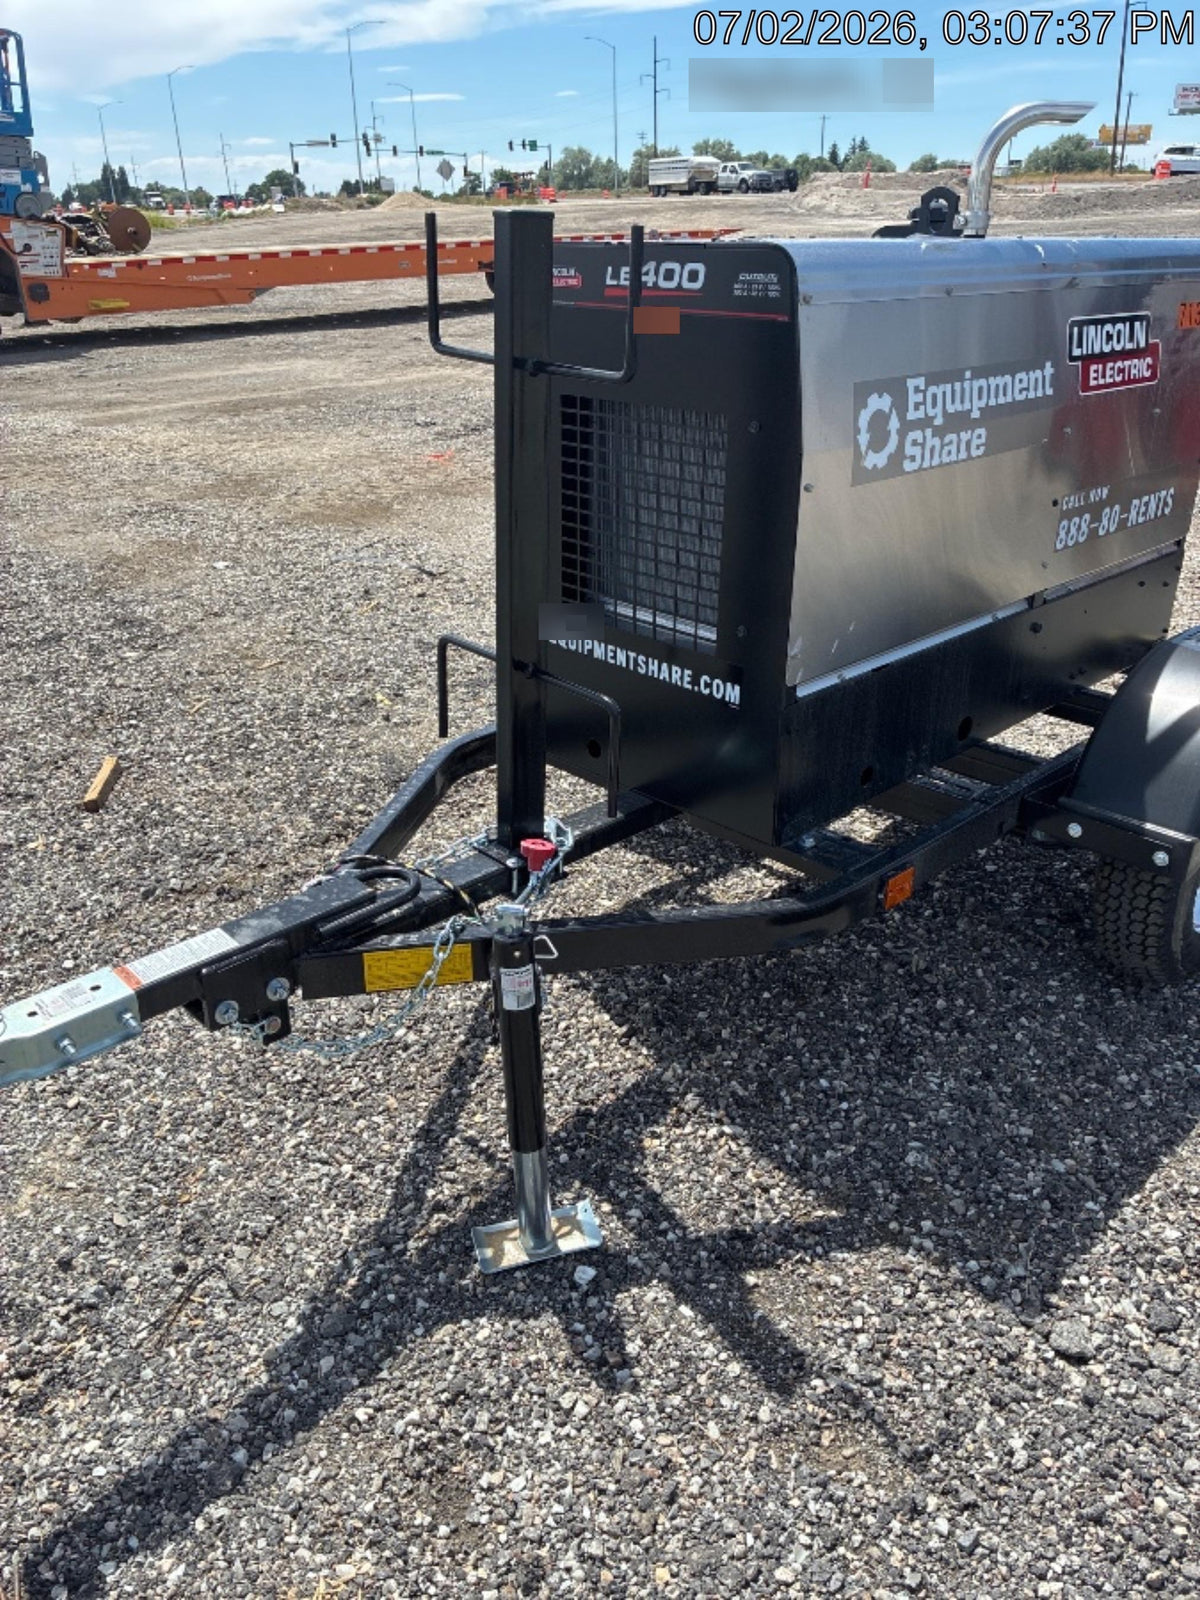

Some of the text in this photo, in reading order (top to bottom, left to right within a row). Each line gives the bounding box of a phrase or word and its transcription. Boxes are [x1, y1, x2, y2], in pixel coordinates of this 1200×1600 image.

[552, 267, 575, 277] NCOLN
[1071, 320, 1147, 357] LINCOLN
[1089, 356, 1153, 387] ELECTRIC
[906, 361, 1055, 426] Equipment
[902, 427, 987, 473] Share
[1088, 485, 1111, 504] NOW
[1055, 487, 1175, 550] 888-80-RENTS
[548, 640, 741, 705] UIPMENTSHARE.COM
